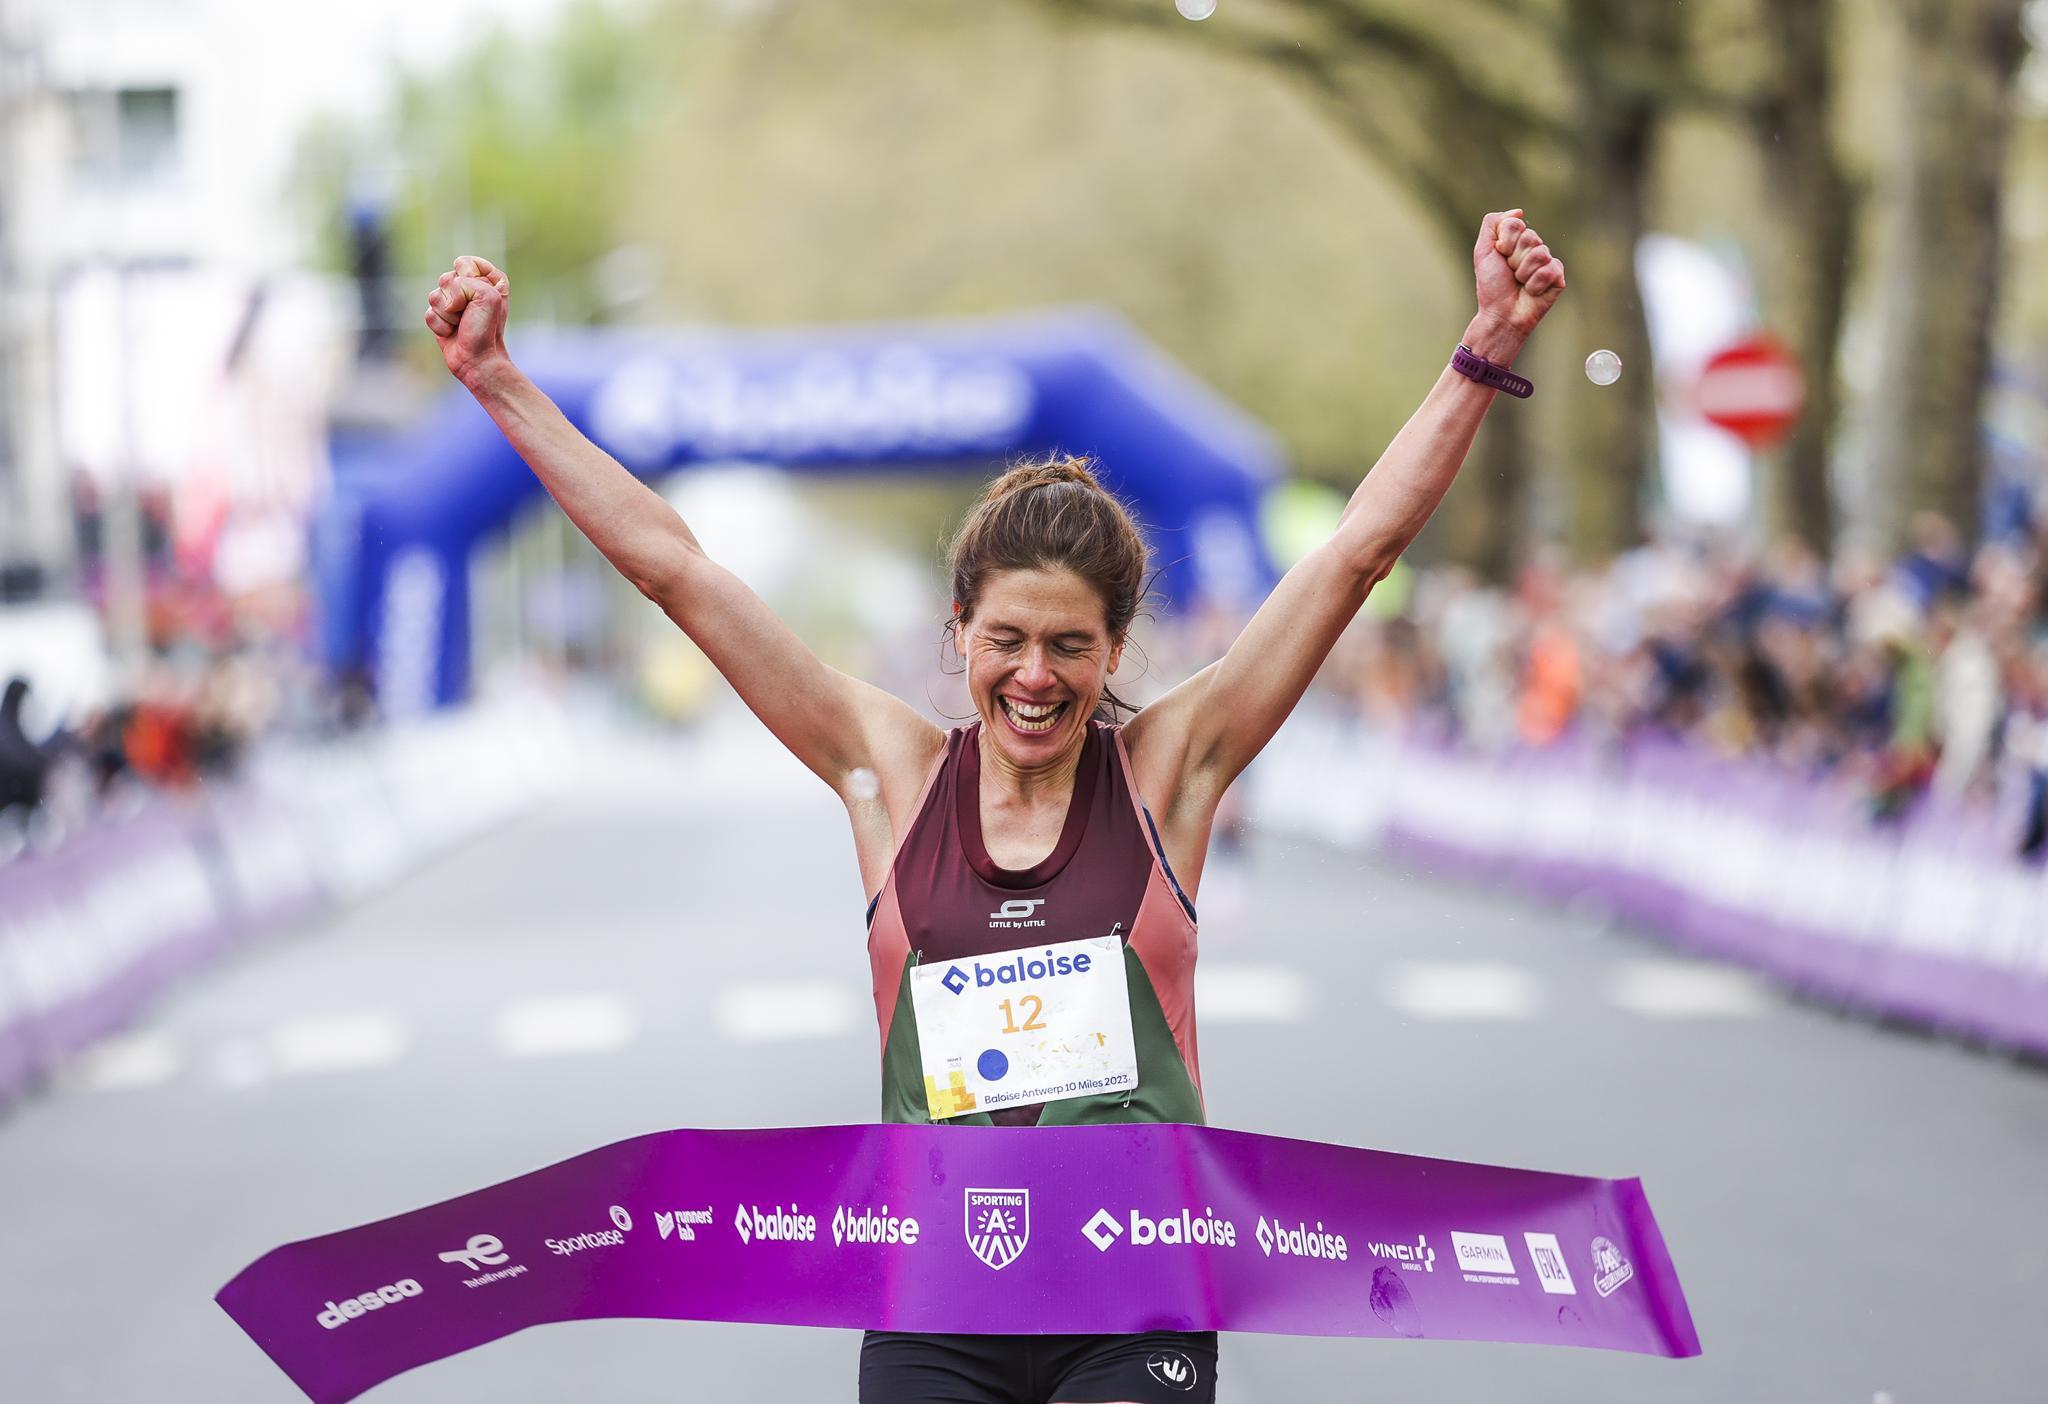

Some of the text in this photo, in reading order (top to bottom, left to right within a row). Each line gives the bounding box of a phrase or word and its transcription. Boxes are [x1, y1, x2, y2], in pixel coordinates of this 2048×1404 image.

[975, 950, 1092, 988] baloise
[998, 994, 1047, 1034] 12
[984, 1074, 1128, 1105] Baloise Antwerp 10 Miles 2023
[971, 1195, 1022, 1206] SPORTING
[752, 1203, 817, 1242] baloise
[846, 1205, 920, 1245] baloise
[1130, 1206, 1236, 1247] baloise
[1273, 1219, 1348, 1261] baloise
[544, 1229, 625, 1256] Sportoase
[1367, 1241, 1415, 1261] VINCI
[1460, 1244, 1505, 1261] GARMIN
[1534, 1247, 1566, 1282] GVA
[316, 1277, 424, 1330] desco
